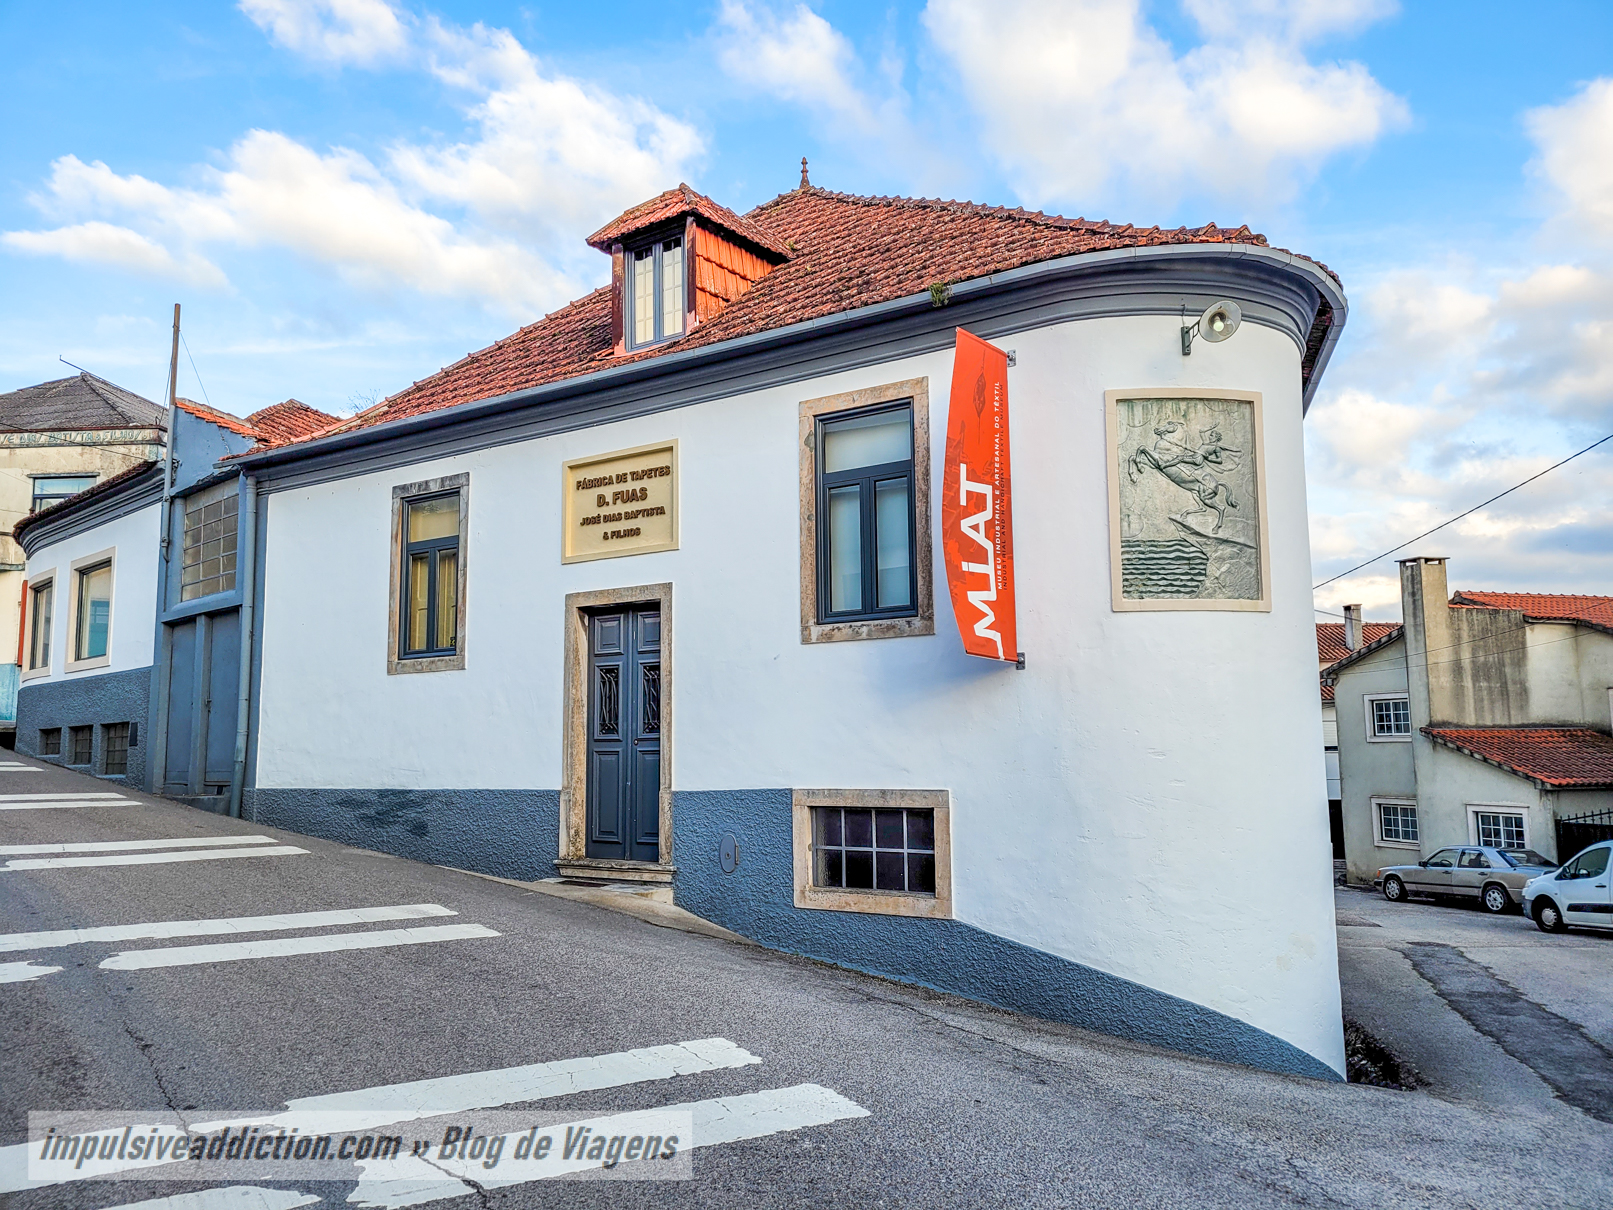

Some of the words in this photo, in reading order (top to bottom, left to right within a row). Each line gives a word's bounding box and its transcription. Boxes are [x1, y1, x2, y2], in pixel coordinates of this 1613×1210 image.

[994, 416, 1000, 429] DO
[576, 475, 614, 490] FÁBRICA
[616, 472, 628, 484] DE
[629, 465, 671, 481] TAPETES
[597, 494, 609, 507] D.
[612, 487, 648, 505] FUAS
[580, 513, 601, 526] JOSÉ
[603, 512, 622, 523] DIAS
[624, 506, 666, 520] BAPTISTA
[603, 531, 609, 540] &
[611, 527, 641, 539] FILHOS
